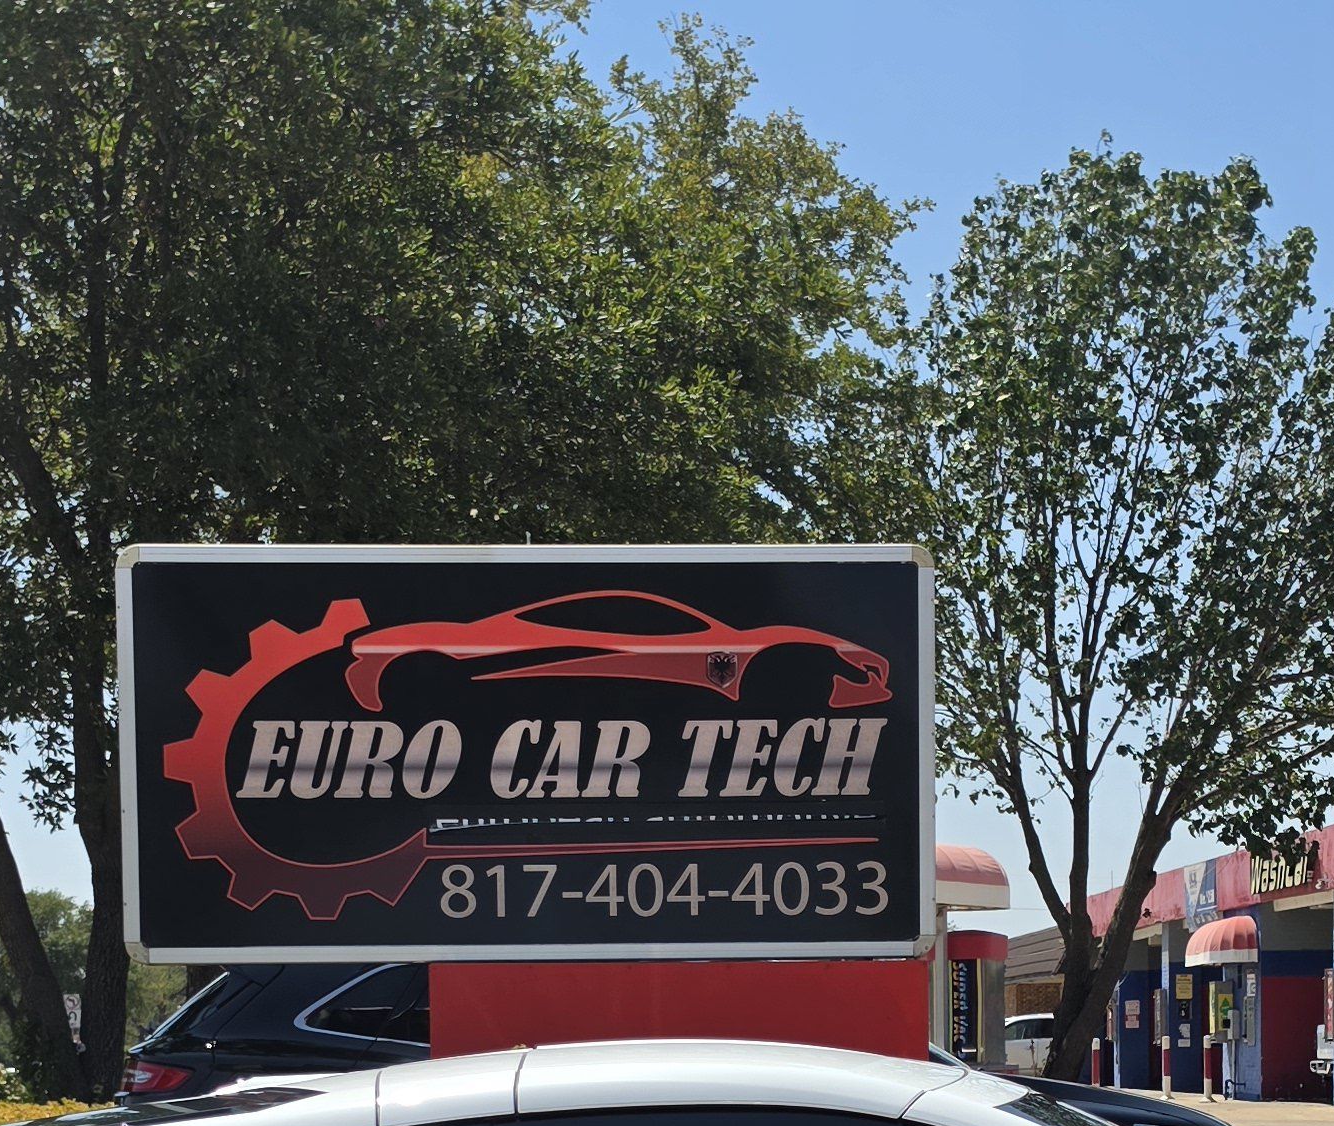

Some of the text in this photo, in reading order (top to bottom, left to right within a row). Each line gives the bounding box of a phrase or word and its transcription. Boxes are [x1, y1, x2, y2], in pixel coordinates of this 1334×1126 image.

[236, 717, 888, 800] EURO CAR TECH
[439, 861, 889, 919] 817-404-4033
